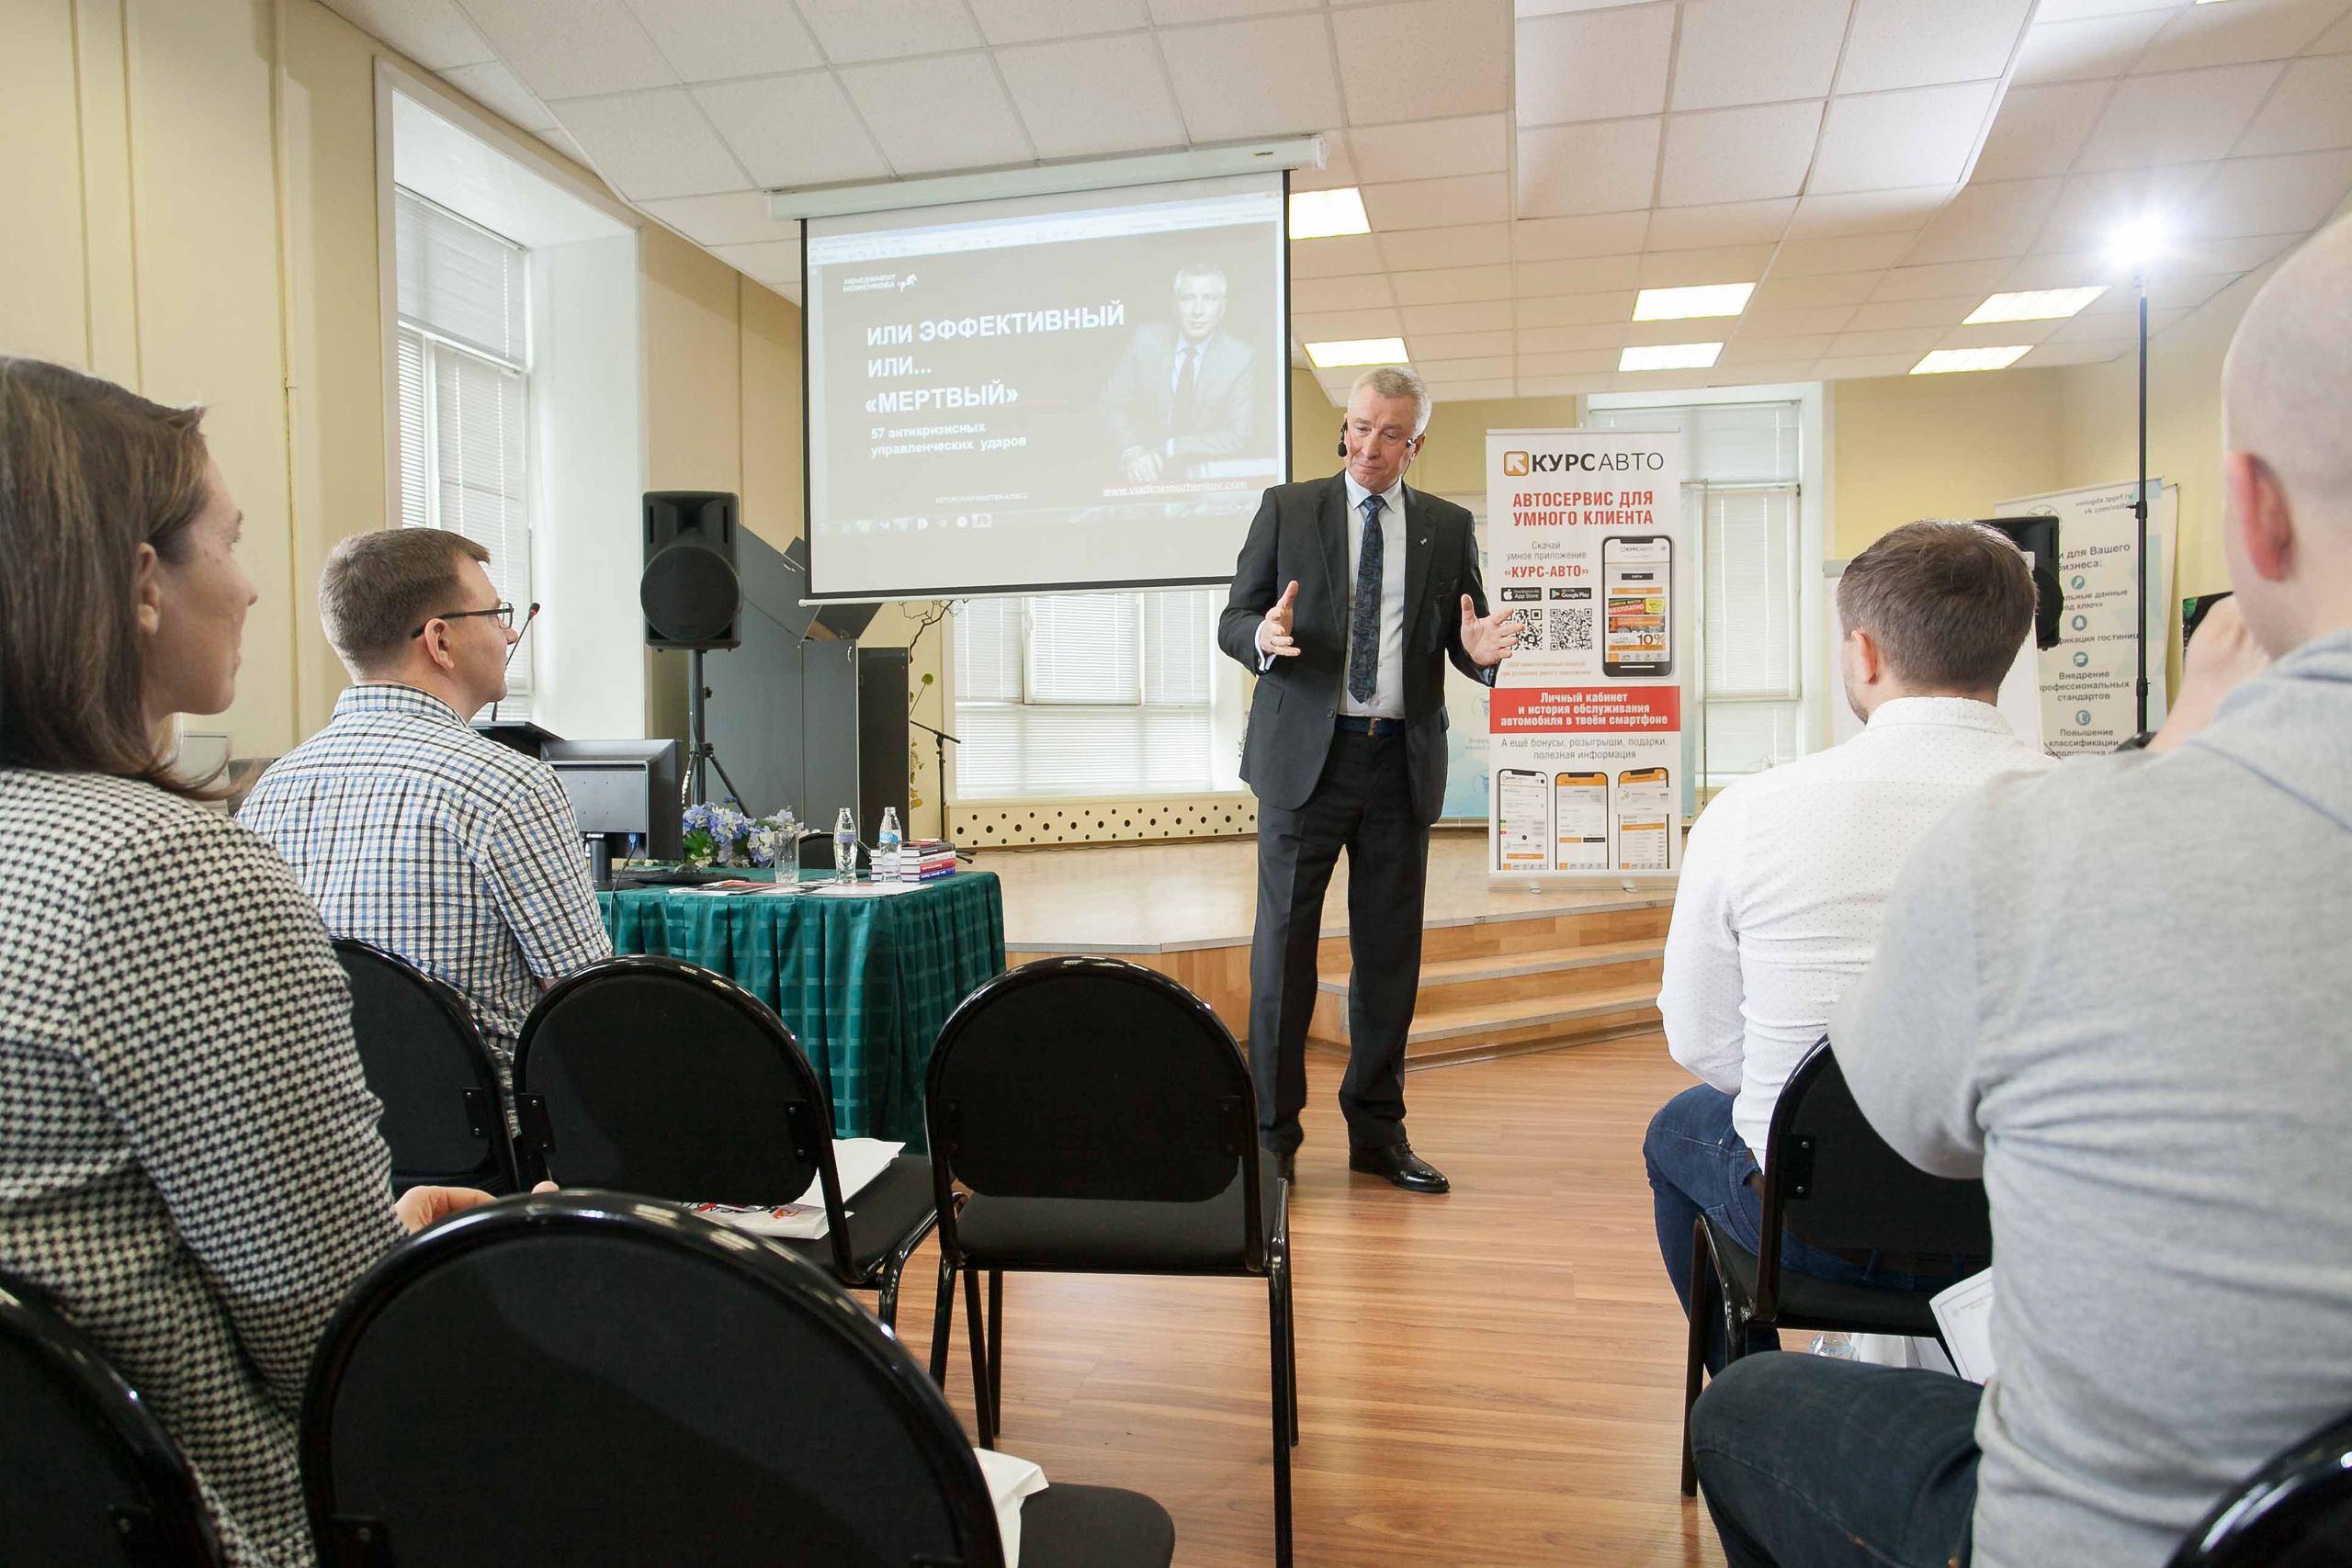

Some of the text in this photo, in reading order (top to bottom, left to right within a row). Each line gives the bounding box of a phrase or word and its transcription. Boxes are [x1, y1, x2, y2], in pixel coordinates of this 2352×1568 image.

[867, 299, 1125, 346] ИЛИ ЭФФЕКТИВНЫЙ
[867, 355, 932, 378] ИЛИ...
[865, 378, 1019, 413] «МЕРТВЫЙ»
[871, 423, 986, 439] 57 антикризисных
[871, 436, 1027, 458] управленческих ударов
[1512, 491, 1654, 508] АВТОСЕРВИС ДЛЯ
[2075, 493, 2133, 507] vologda.tpprf.ru
[1512, 510, 1654, 526] УМНОГО КЛИЕНТА
[1532, 541, 1561, 550] Скачай
[2066, 549, 2086, 559] для
[2090, 544, 2131, 556] Вашего
[1506, 551, 1587, 561] умное приложение
[1504, 565, 1589, 578] «КУРС-АВТО»
[2095, 590, 2128, 598] данные
[2059, 671, 2110, 681] Внедрение
[1540, 692, 1628, 704] Личный кабинет
[2057, 694, 2110, 702] стандартов
[1528, 705, 1570, 715] история
[1573, 704, 1650, 715] обслуживания
[1500, 716, 1563, 726] автомобиля
[1575, 716, 1606, 726] твоём
[1609, 715, 1668, 727] смартфоне
[1501, 739, 1508, 747] А
[1510, 738, 1528, 748] ещё
[1533, 750, 1636, 761] полезная информация
